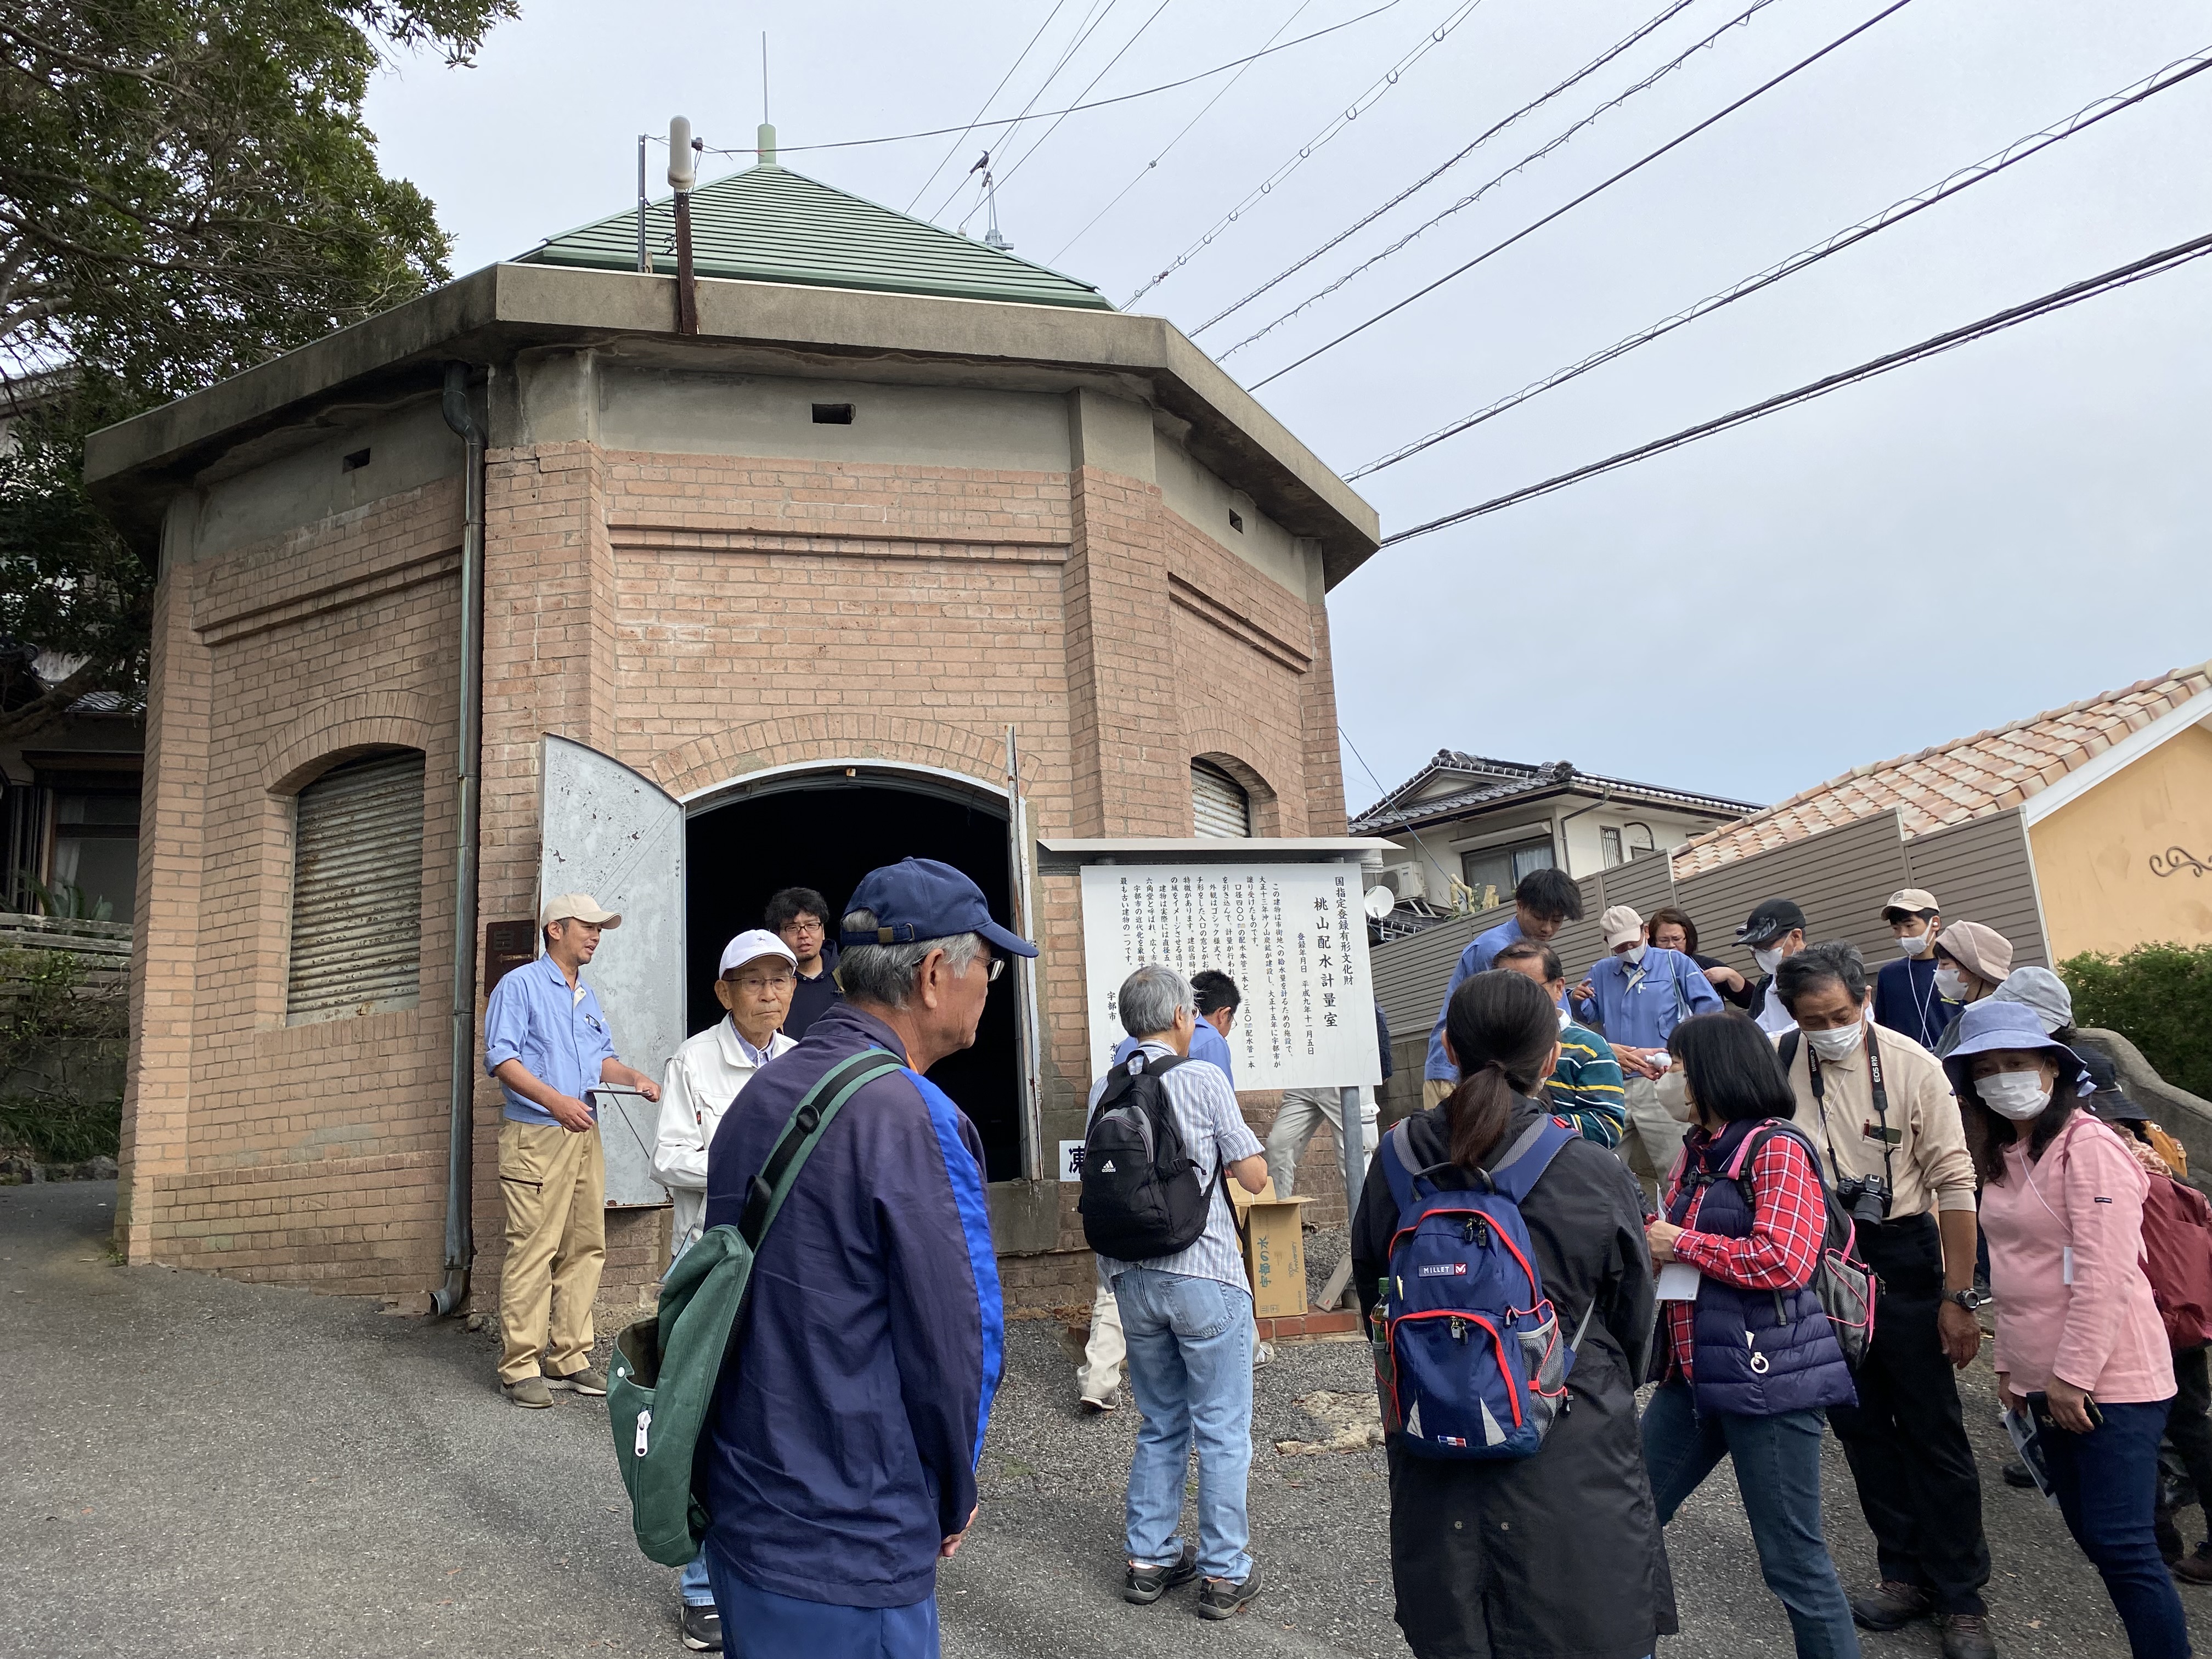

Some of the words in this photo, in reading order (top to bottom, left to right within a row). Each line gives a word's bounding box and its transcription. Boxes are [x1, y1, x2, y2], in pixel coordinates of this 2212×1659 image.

[1120, 877, 1132, 966] 最も古い建物の一つです。
[1313, 896, 1338, 1027] 桃山配水計量室
[1335, 876, 1353, 985] 国指定登録有形文化財
[1107, 991, 1117, 1022] 宇部市
[1297, 932, 1307, 973] 登録年月日
[1302, 980, 1314, 1055] 平成九年十一月五日
[1872, 1066, 1881, 1082] EOS
[1257, 1235, 1272, 1288] 宇部の水
